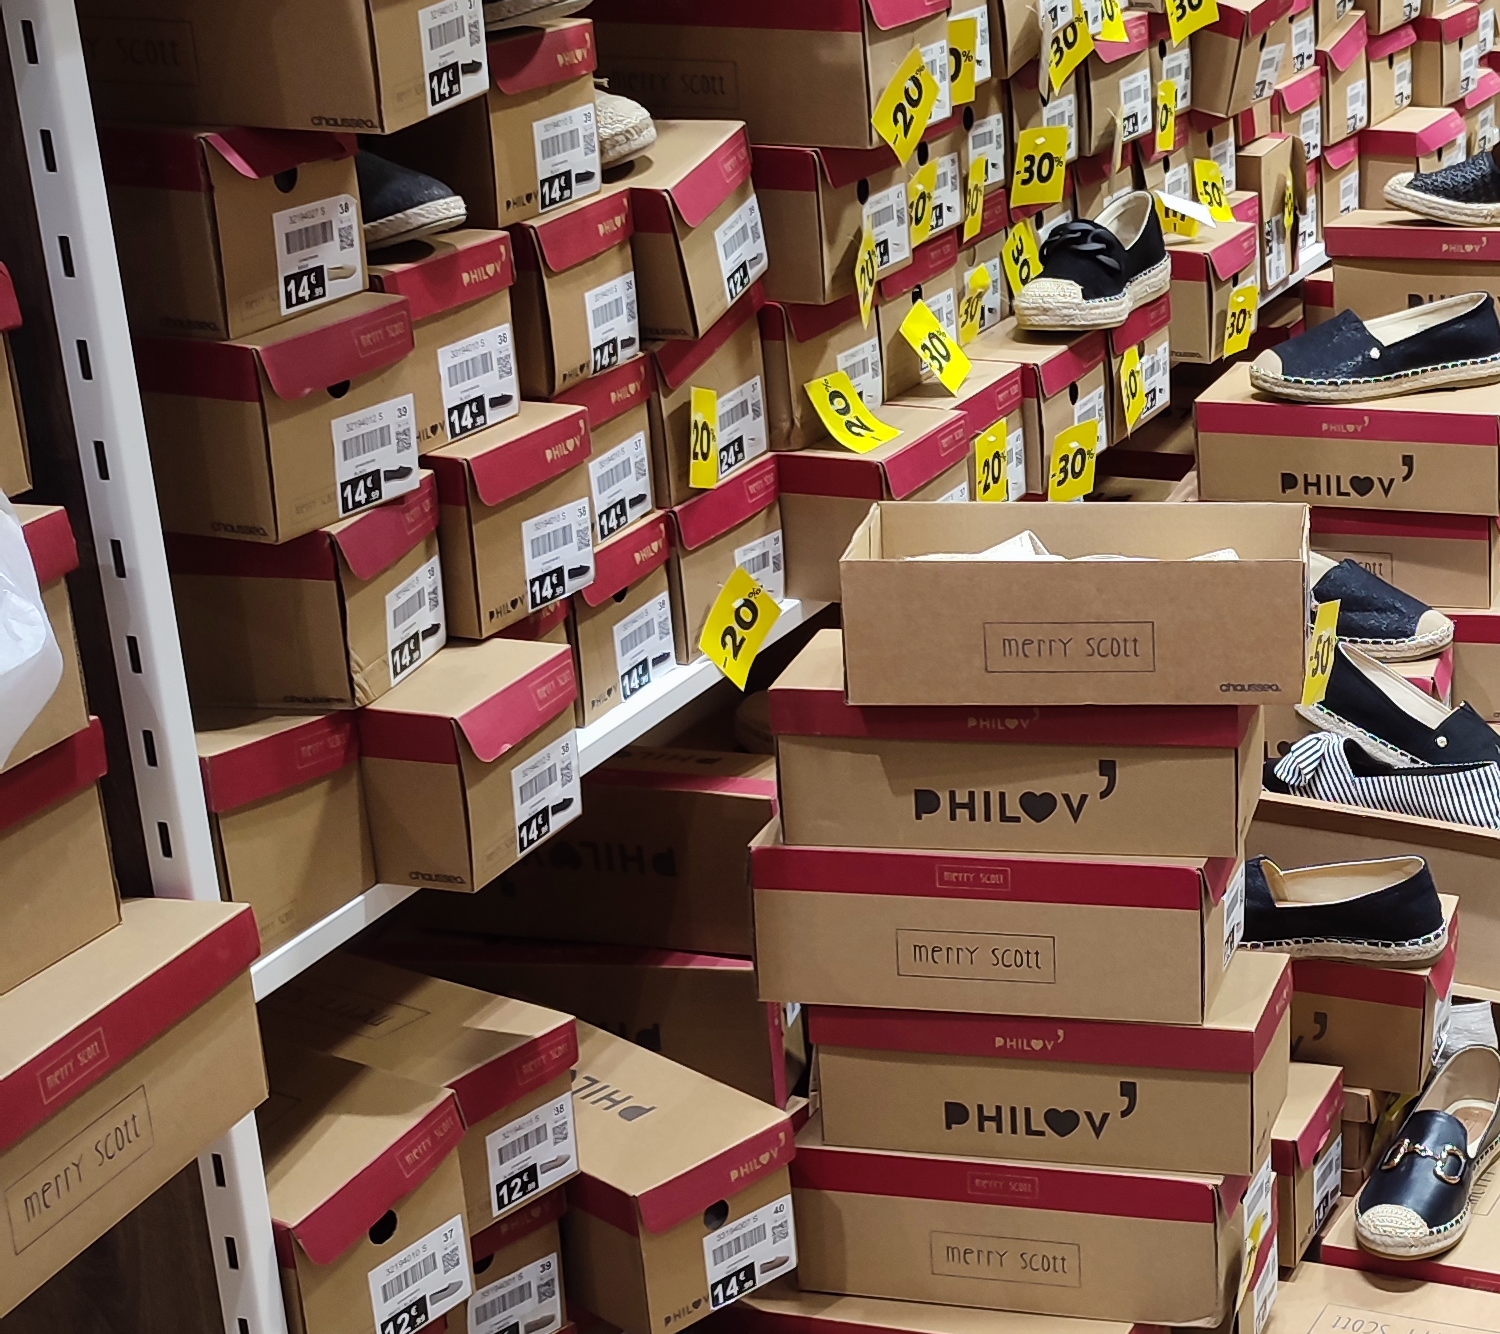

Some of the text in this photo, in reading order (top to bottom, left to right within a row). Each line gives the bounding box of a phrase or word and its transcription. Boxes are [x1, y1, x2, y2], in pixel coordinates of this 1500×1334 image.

[1016, 152, 1064, 186] -30%
[1051, 448, 1094, 488] -30%
[722, 584, 764, 668] -20%
[1001, 634, 1139, 659] merry scott
[912, 942, 1043, 970] merry scott
[554, 1104, 565, 1116] 38
[23, 1114, 140, 1222] merry scott
[773, 1204, 784, 1214] 40
[443, 1230, 453, 1243] 37
[945, 1244, 1067, 1274] merry scott
